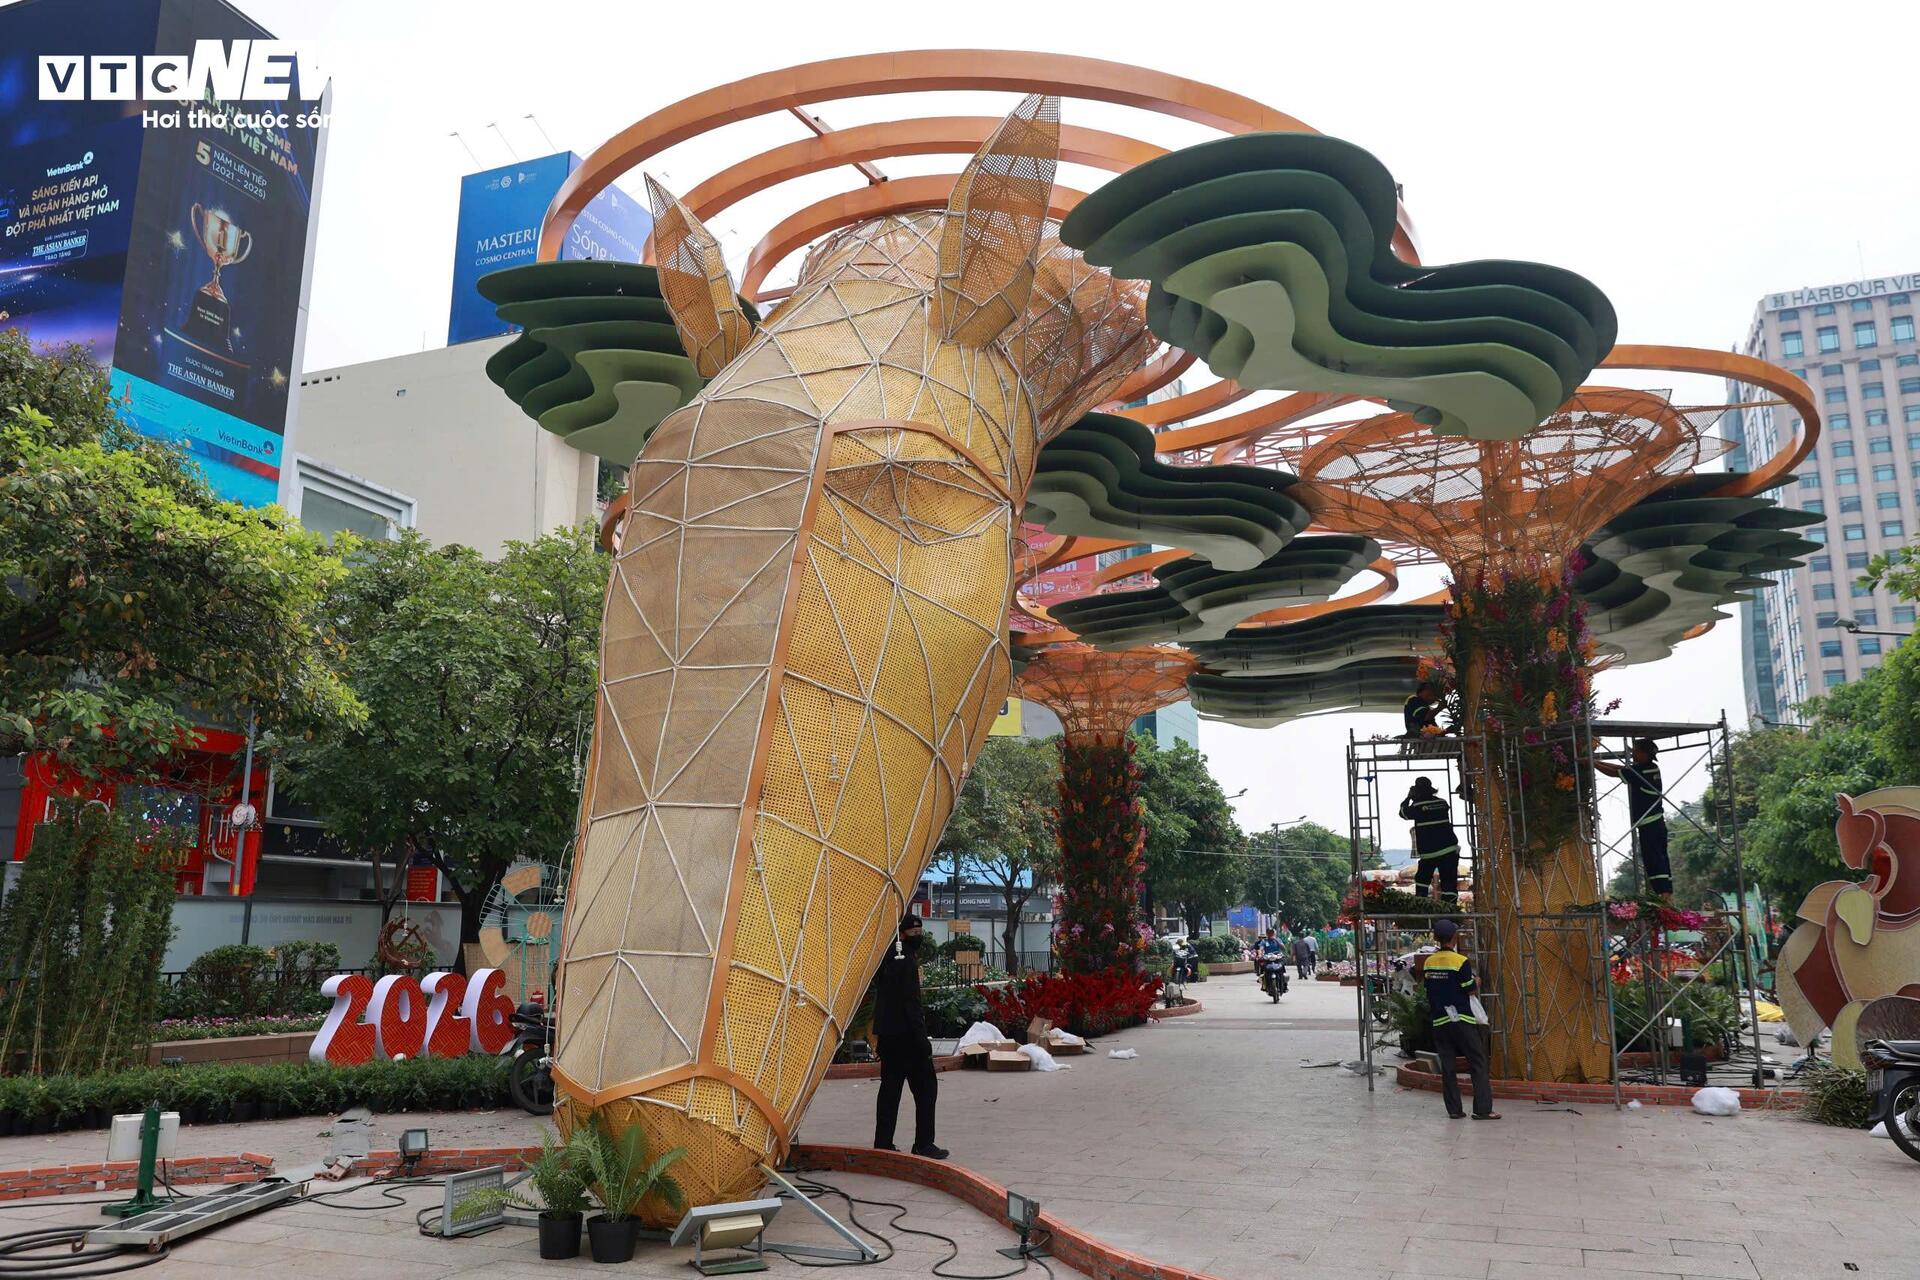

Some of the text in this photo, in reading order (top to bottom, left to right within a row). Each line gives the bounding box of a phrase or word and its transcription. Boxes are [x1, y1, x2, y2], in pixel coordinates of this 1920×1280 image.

[195, 141, 211, 166] 5
[240, 130, 267, 156] VIỆT
[270, 150, 298, 175] NAM
[266, 131, 292, 154] SME
[46, 161, 84, 177] VietinBank
[212, 162, 234, 180] (2021
[243, 181, 266, 200] 2025)
[213, 150, 267, 186] NĂM LIÊN TIẾP
[32, 174, 98, 200] SÁNG KIẾN API
[18, 184, 109, 219] VÀ NGÂN HÀNG MỞ
[5, 200, 120, 237] ĐỘT PHÁ NHẤT VIỆT NAM
[33, 235, 87, 254] THE ASIAN BANKER
[476, 227, 537, 254] MASTERI
[572, 223, 607, 261] Sống
[475, 247, 535, 267] COSMO CENTRAL
[1792, 280, 1886, 306] HARBOUR
[168, 362, 235, 398] THE ASIAN BANKER
[217, 428, 263, 456] VietinBank
[309, 968, 516, 1066] 2026
